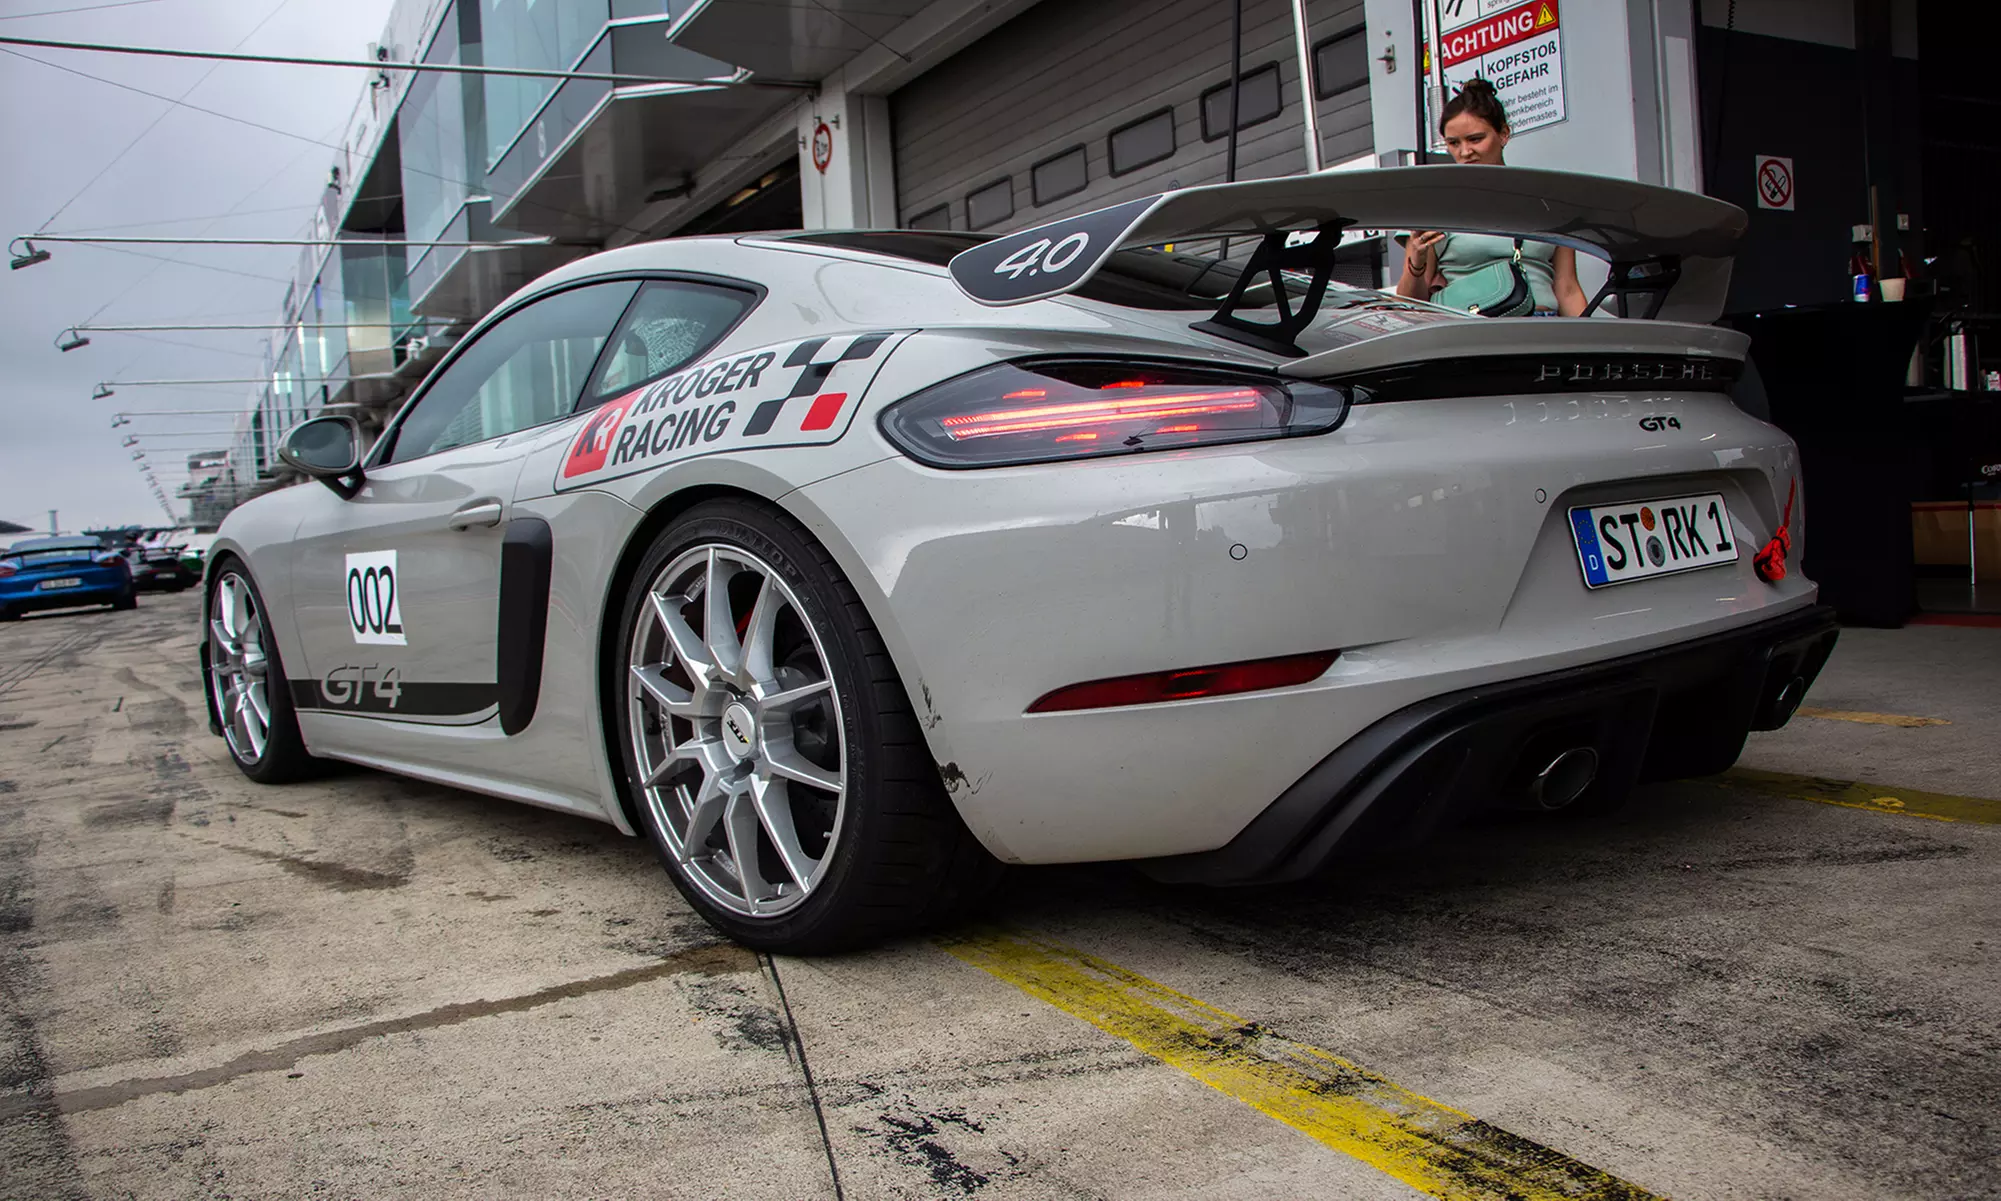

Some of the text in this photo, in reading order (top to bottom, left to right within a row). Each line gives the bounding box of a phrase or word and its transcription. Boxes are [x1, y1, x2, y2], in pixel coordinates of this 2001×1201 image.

[1442, 11, 1533, 60] ACHTUNG
[1496, 62, 1549, 90] GEFAHR
[1517, 87, 1547, 103] besteht
[1548, 85, 1559, 94] im
[993, 231, 1090, 280] 4.0
[1533, 363, 1713, 383] PORSCHE
[611, 400, 736, 467] RACING
[1639, 416, 1682, 432] GT4
[1599, 501, 1732, 571] ST RK 1
[1589, 554, 1599, 571] D
[347, 565, 404, 635] 002
[320, 662, 402, 709] GT4
